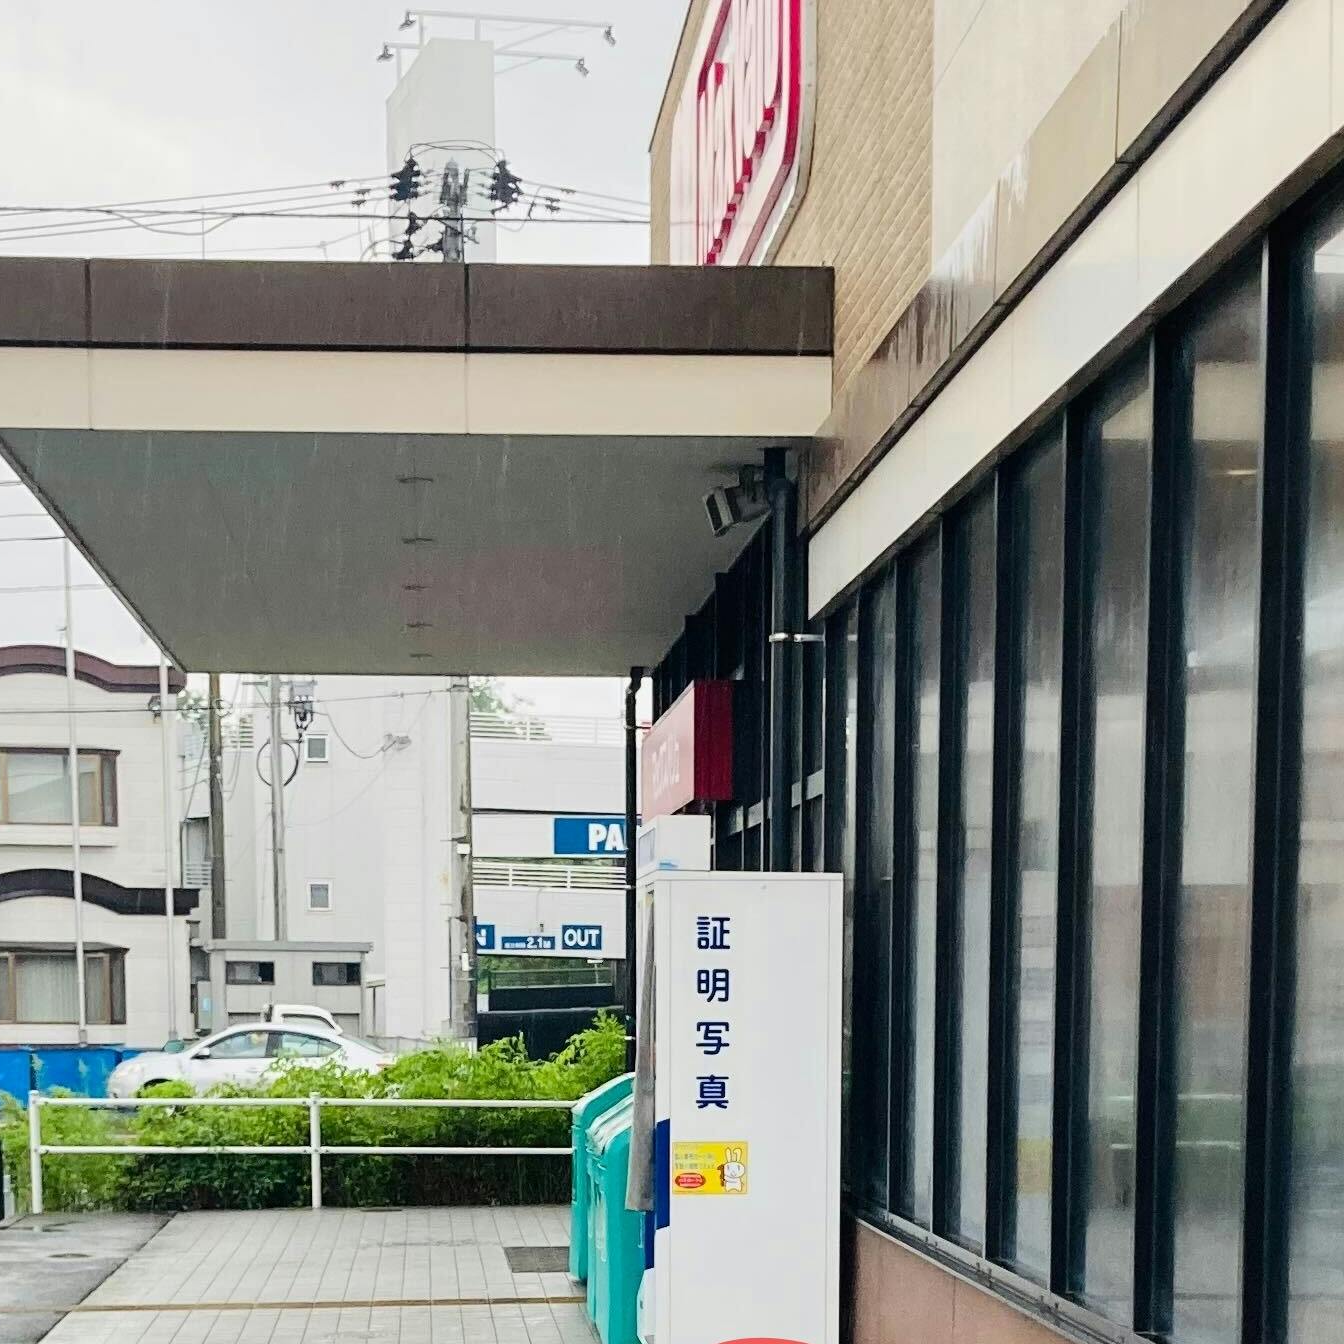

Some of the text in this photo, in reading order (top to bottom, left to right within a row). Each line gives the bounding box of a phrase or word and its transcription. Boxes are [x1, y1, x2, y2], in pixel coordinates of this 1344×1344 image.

[588, 823, 627, 851] PA
[564, 928, 600, 947] OUT
[696, 916, 731, 1109] 証明写真
